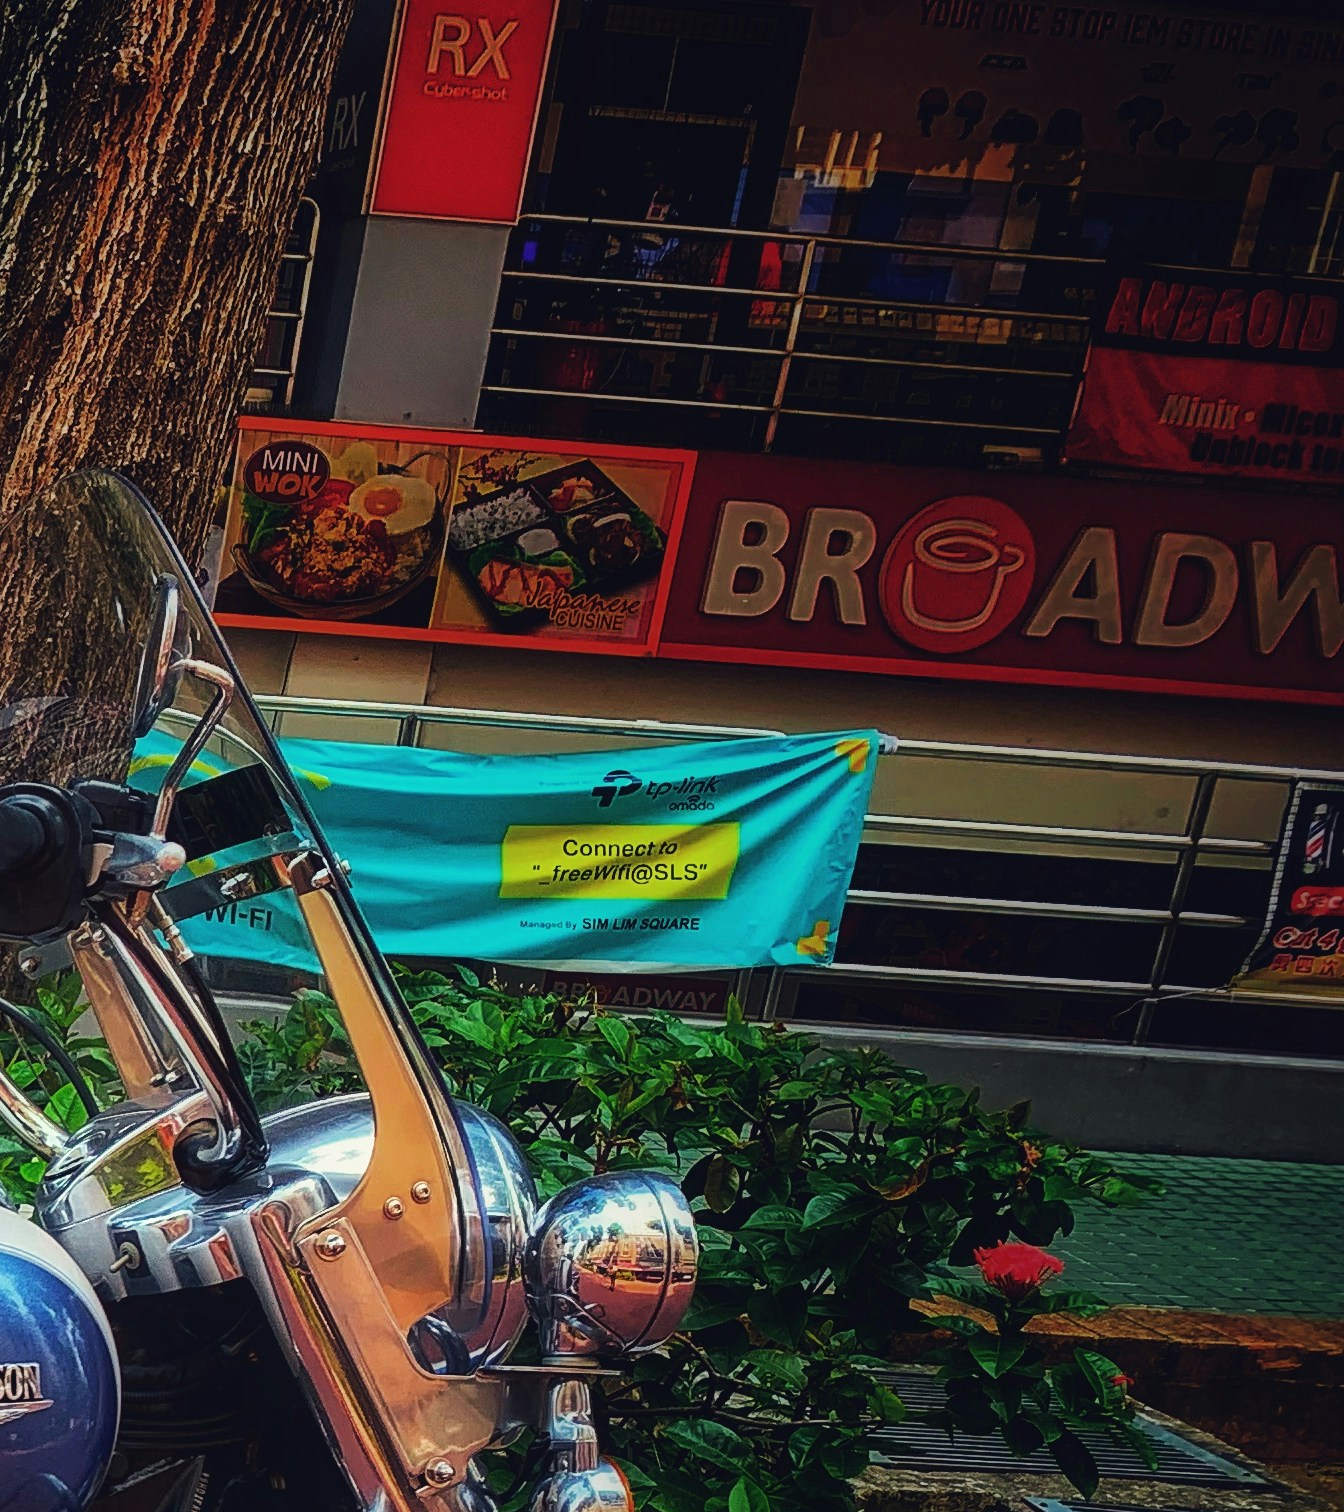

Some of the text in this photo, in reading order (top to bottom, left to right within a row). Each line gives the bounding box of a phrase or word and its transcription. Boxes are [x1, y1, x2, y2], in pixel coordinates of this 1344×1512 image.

[990, 4, 1045, 36] ONE
[1049, 9, 1117, 41] STOP
[426, 13, 520, 80] RX
[1105, 277, 1339, 352] ANDROID
[262, 448, 319, 474] MINI
[253, 469, 320, 498] WOK
[523, 580, 640, 620] Japanese
[555, 610, 625, 632] CUISINE
[646, 775, 721, 799] tp-link
[668, 800, 715, 811] omada
[563, 839, 678, 858] Connect to
[519, 917, 700, 931] Managed By SIM LIM SQUARE
